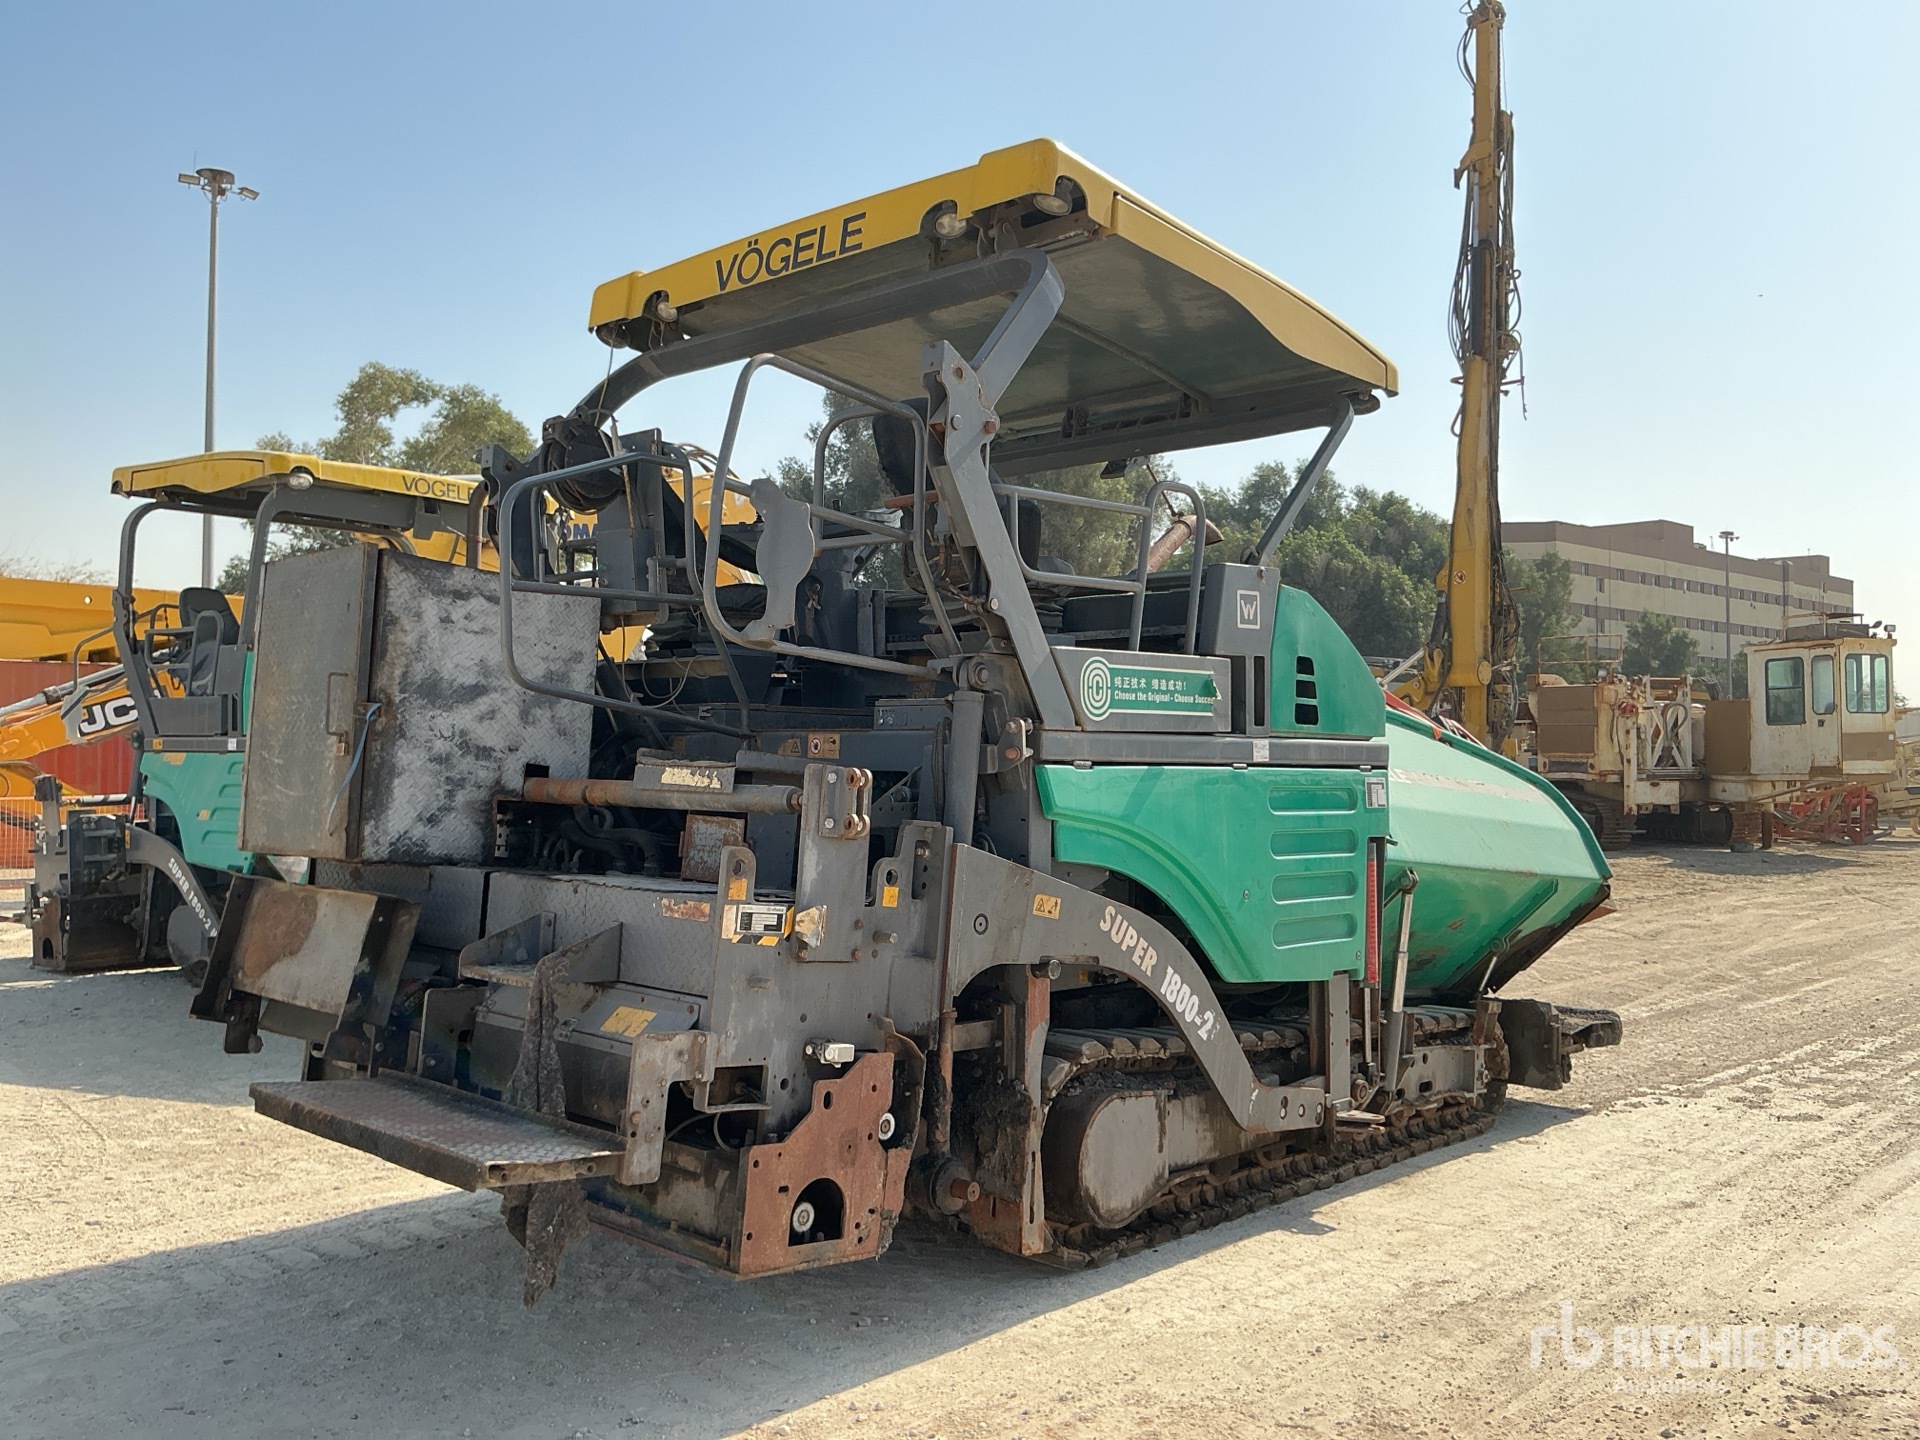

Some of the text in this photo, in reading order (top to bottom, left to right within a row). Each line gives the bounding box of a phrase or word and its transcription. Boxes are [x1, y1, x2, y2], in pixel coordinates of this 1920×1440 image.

[715, 211, 867, 292] VÖGELE
[80, 696, 139, 733] JC
[1114, 690, 1136, 700] Choose
[1137, 691, 1147, 701] the
[1147, 691, 1170, 703] Original
[1174, 693, 1194, 702] Choose
[168, 857, 212, 930] SUPER 1800-2
[1099, 905, 1215, 1041] SUPER 1800-2
